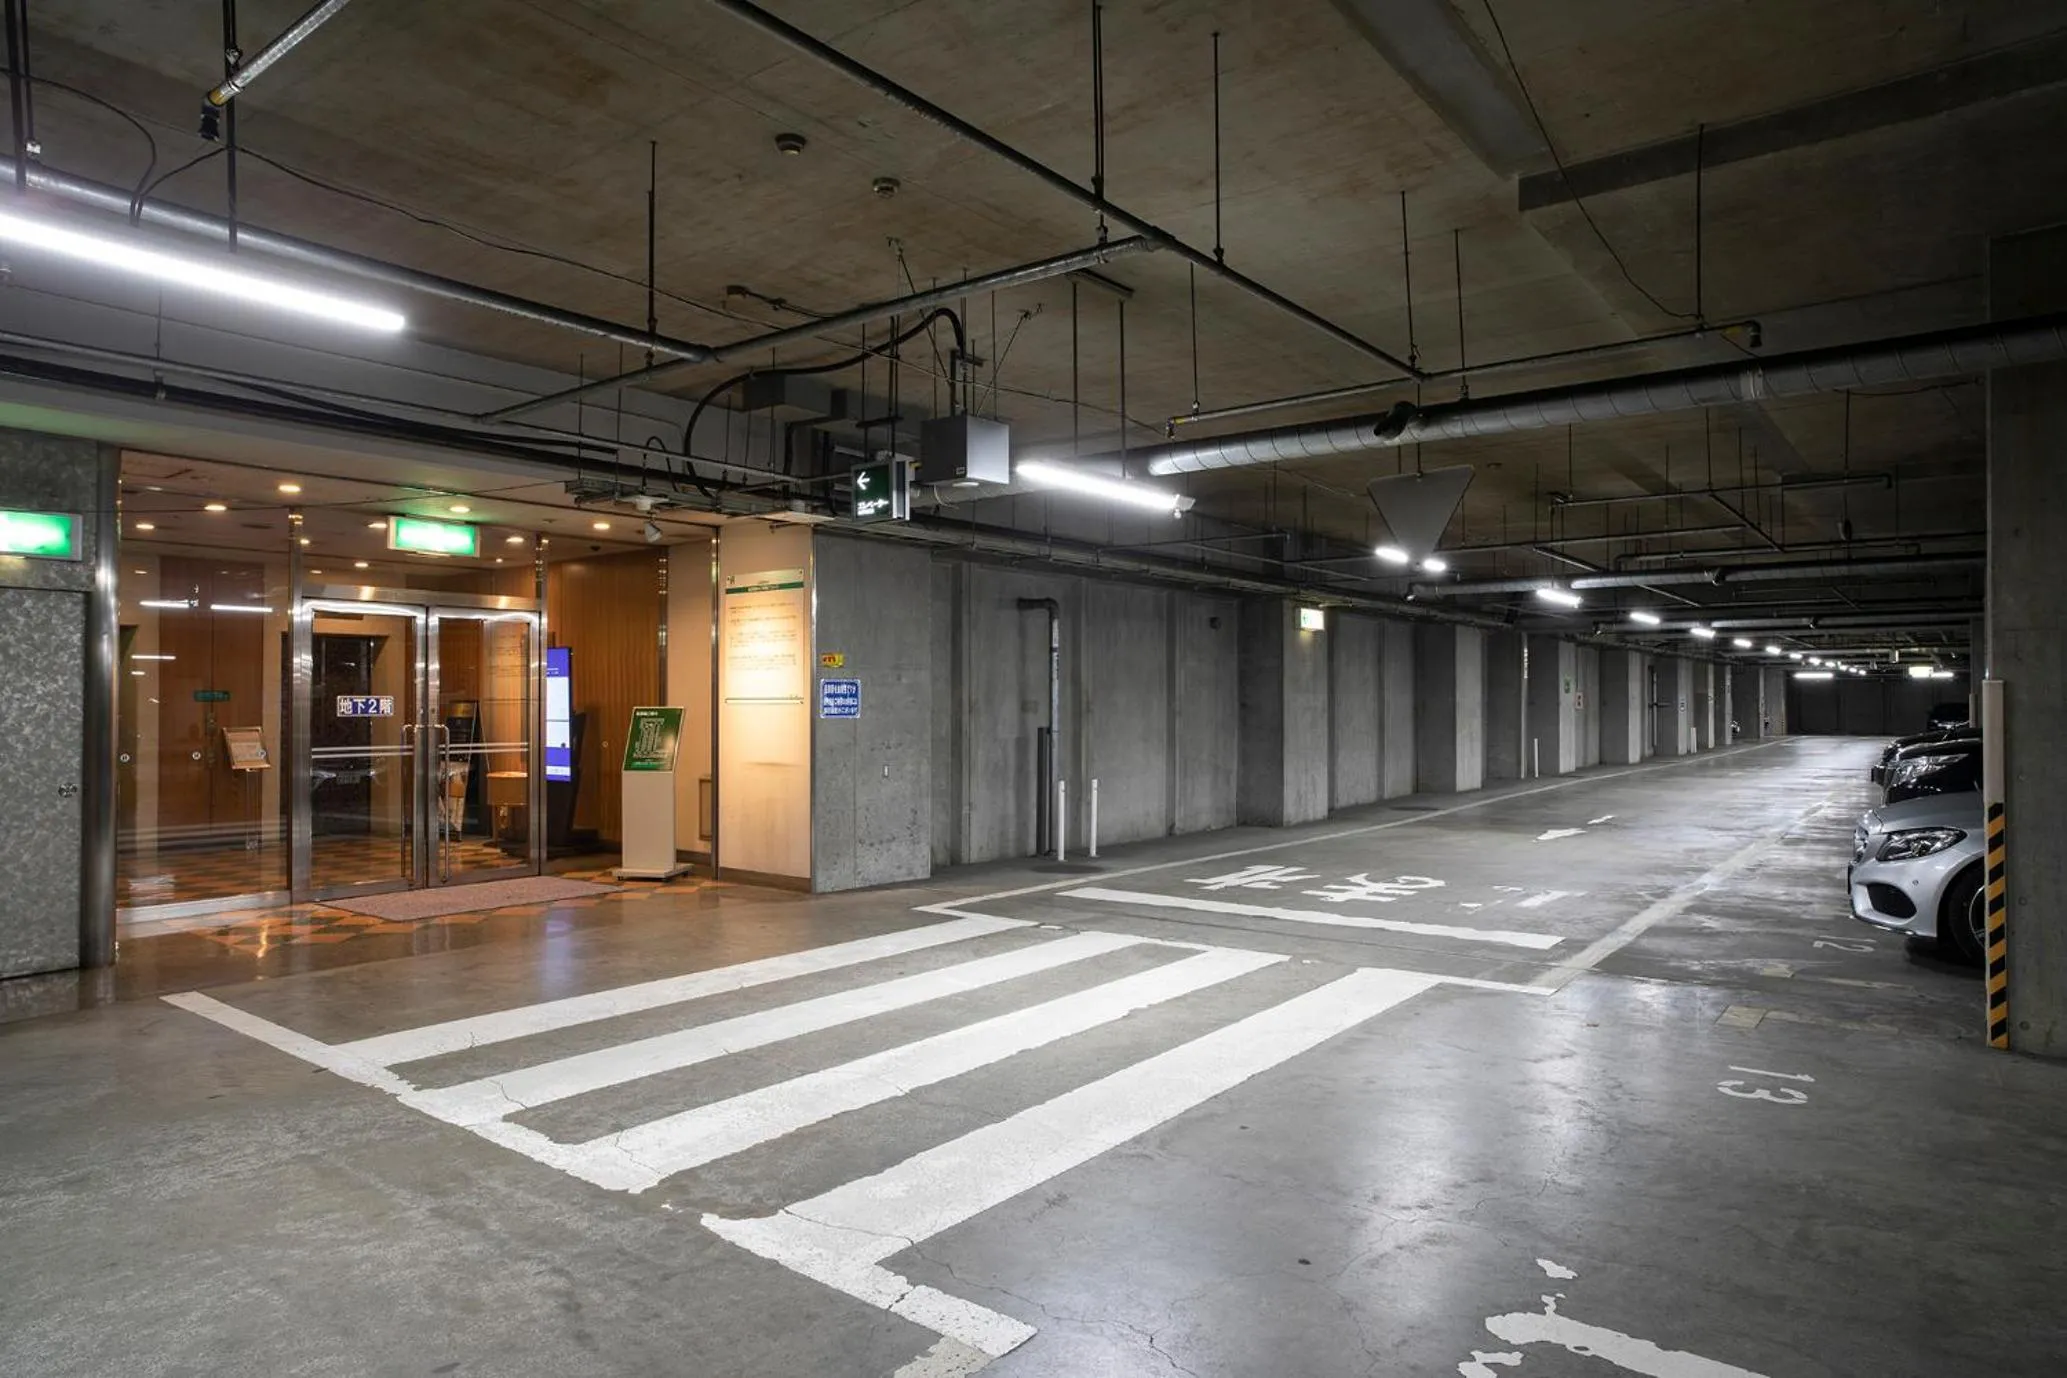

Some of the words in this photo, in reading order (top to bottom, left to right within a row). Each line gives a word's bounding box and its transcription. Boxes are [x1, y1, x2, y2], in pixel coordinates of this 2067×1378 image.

[339, 697, 393, 715] 地下2階
[1812, 934, 1877, 953] 12
[1716, 1064, 1816, 1105] 13
